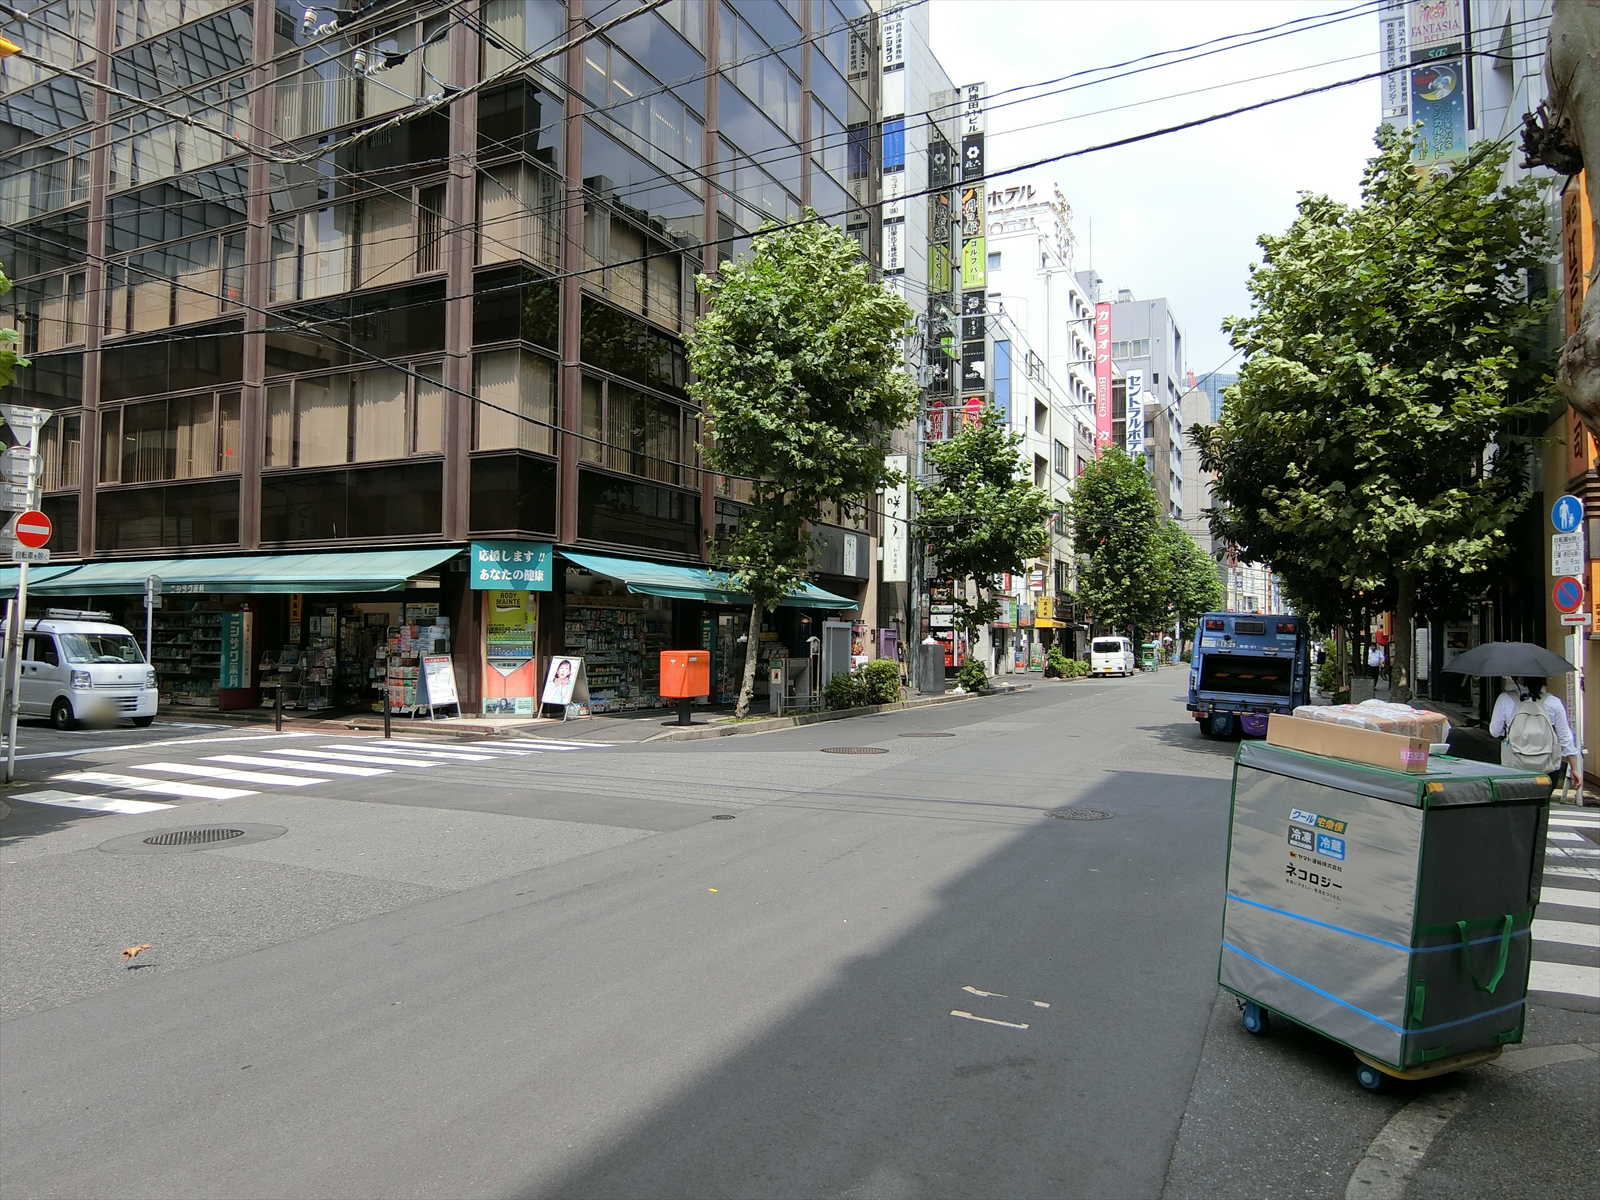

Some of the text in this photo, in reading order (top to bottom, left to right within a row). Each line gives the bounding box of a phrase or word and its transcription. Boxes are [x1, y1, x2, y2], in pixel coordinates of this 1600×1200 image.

[1411, 19, 1460, 37] FANTASIA
[1418, 138, 1428, 160] 4F
[988, 185, 1037, 207] ホテル
[969, 239, 978, 281] ゴルフバー
[1097, 310, 1110, 365] カラオケ
[1098, 376, 1107, 418] BIGECHO
[15, 550, 48, 560] 自転車を除く
[479, 568, 545, 582] あなたの健康
[1292, 810, 1344, 832] クール 宅急便
[1291, 827, 1312, 844] 冷凍
[1320, 836, 1342, 853] 冷蔵
[1298, 854, 1343, 873] ヤマト運輸株式会社
[1285, 861, 1343, 889] ネコロジー
